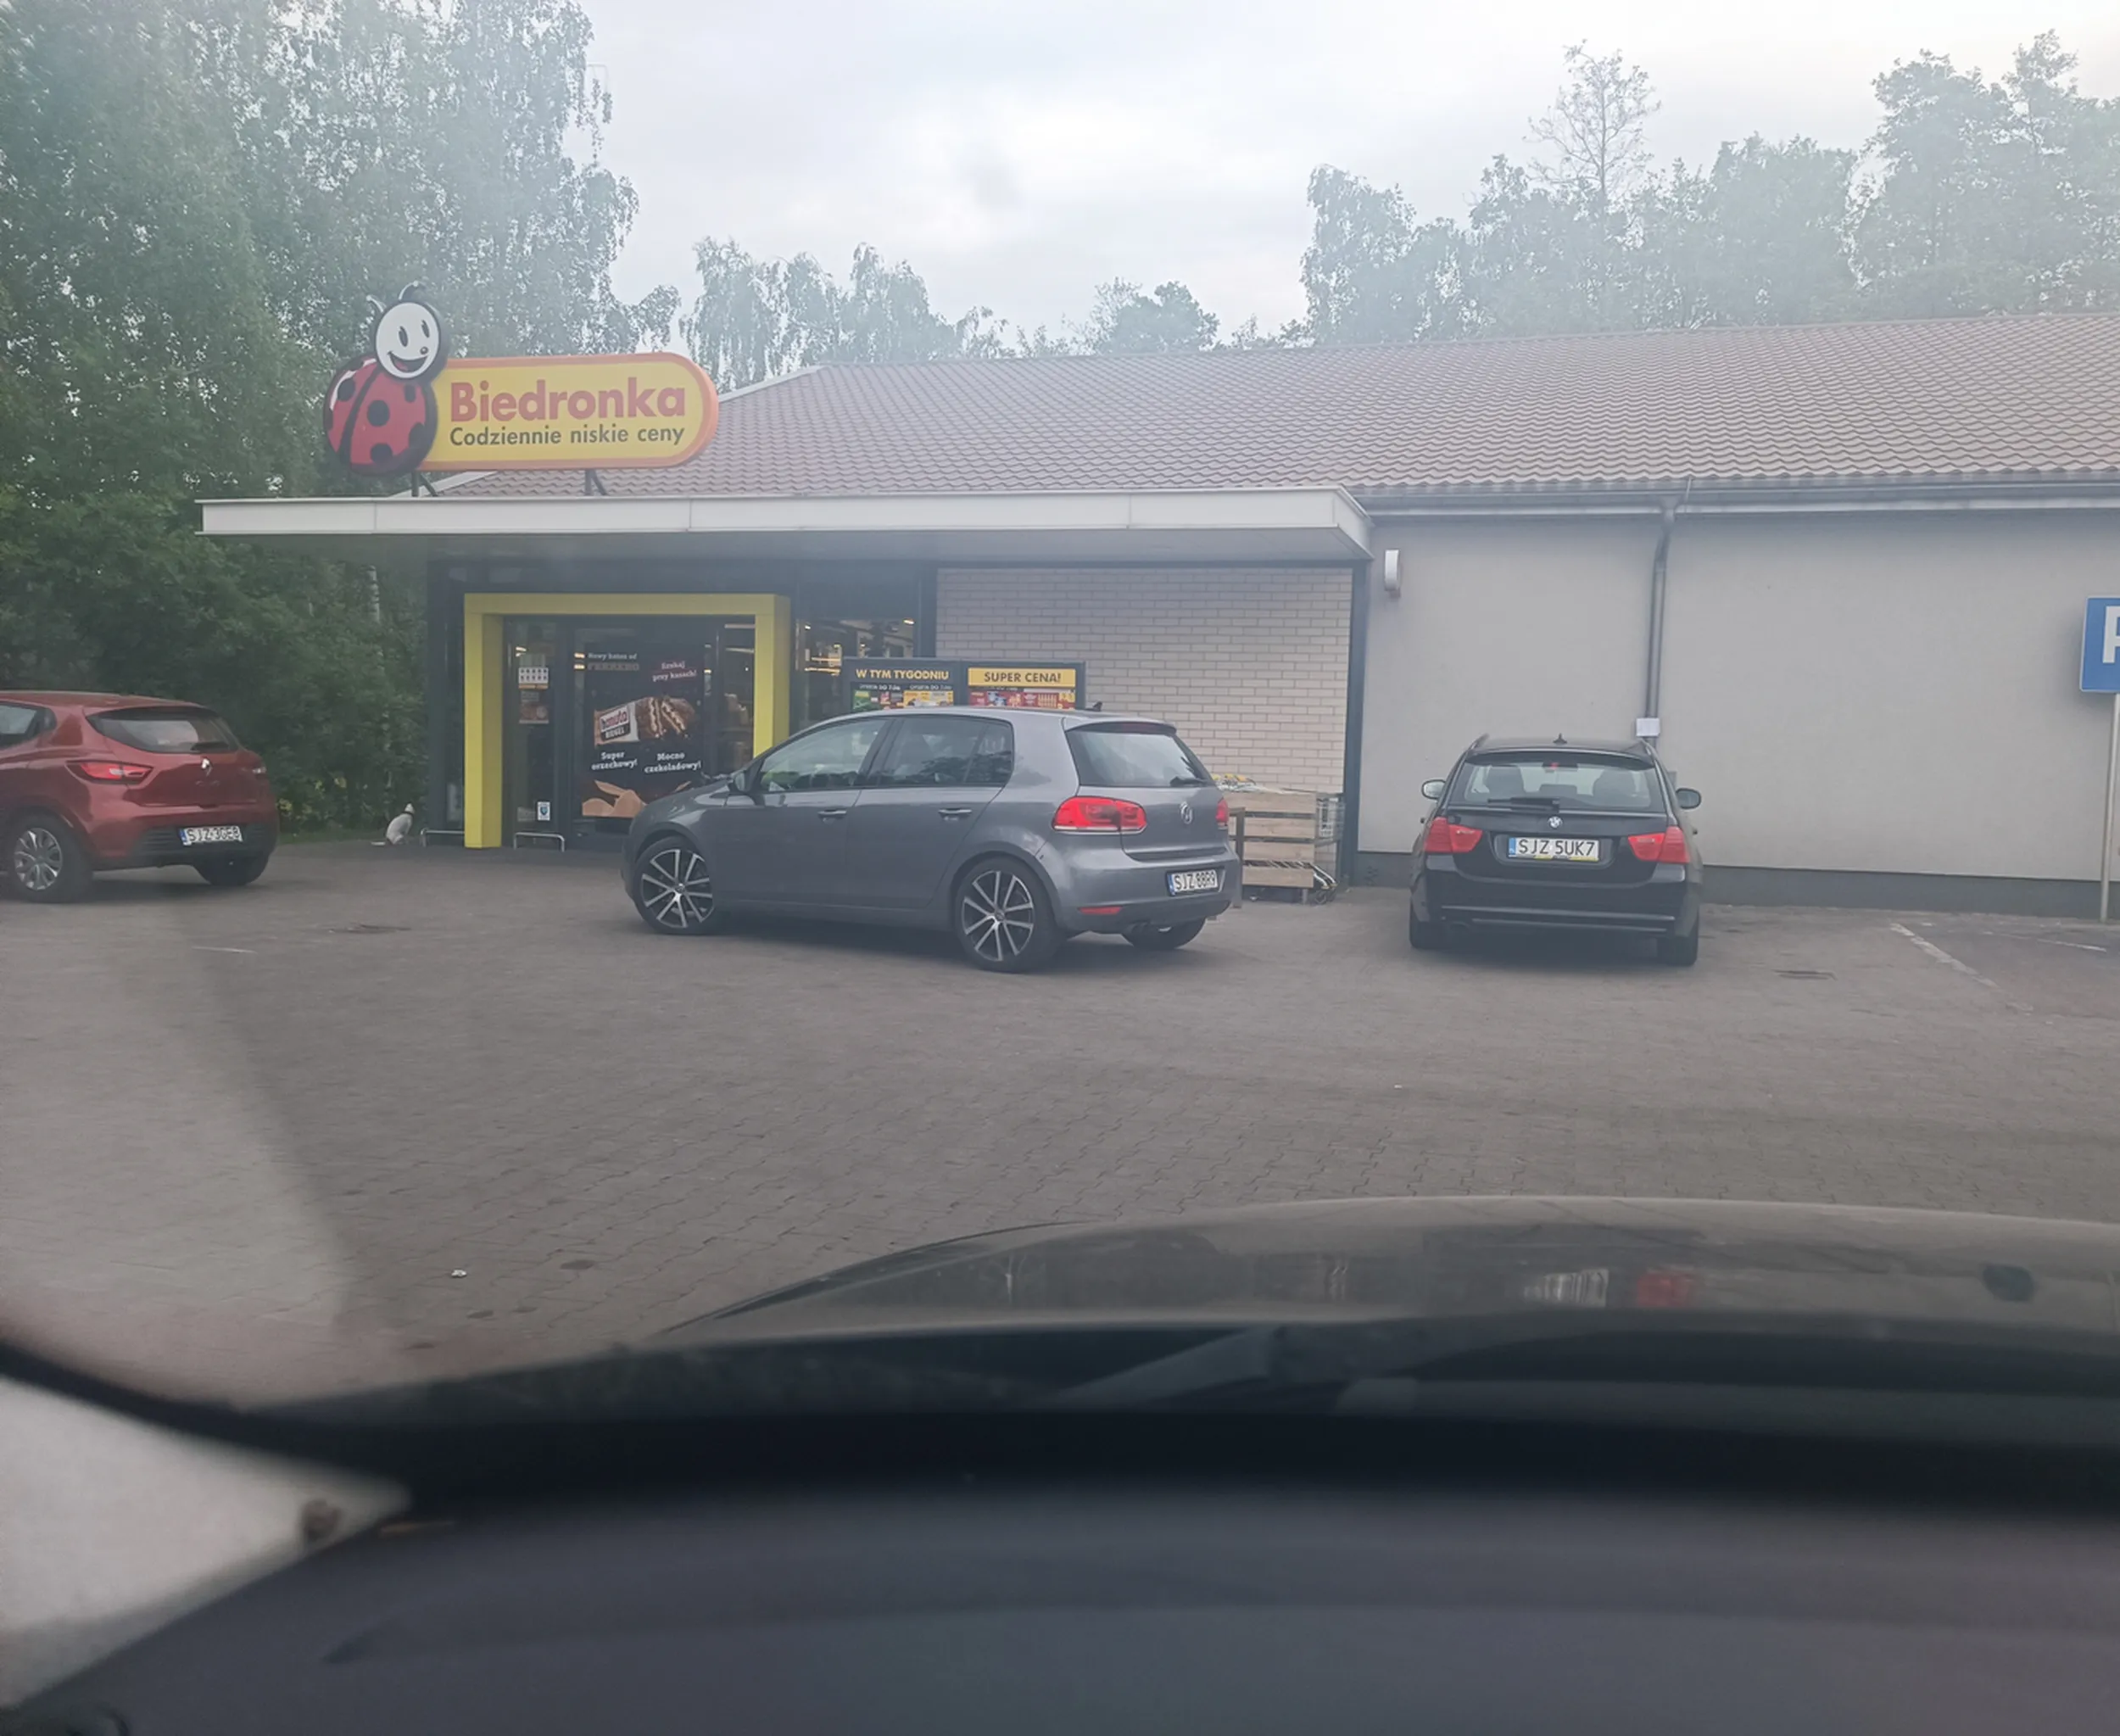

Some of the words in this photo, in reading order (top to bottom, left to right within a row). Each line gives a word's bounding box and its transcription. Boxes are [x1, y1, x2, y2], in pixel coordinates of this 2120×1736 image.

[449, 377, 686, 422] Biedronka
[449, 426, 561, 446] Codziennie
[570, 423, 629, 444] niskie
[638, 426, 685, 445] ceny
[856, 668, 869, 679] W
[870, 669, 891, 679] TYM
[894, 669, 949, 680] TYGODNIU
[984, 672, 1022, 683] SUPER
[1024, 672, 1061, 683] CENA!
[600, 751, 625, 761] Super
[656, 752, 685, 761] Mocno
[591, 758, 638, 771] orzechowy!
[644, 761, 701, 773] czekoladowy!
[1519, 839, 1550, 855] SJZ
[1554, 840, 1595, 856] 5UK7
[1174, 873, 1195, 890] SJZ
